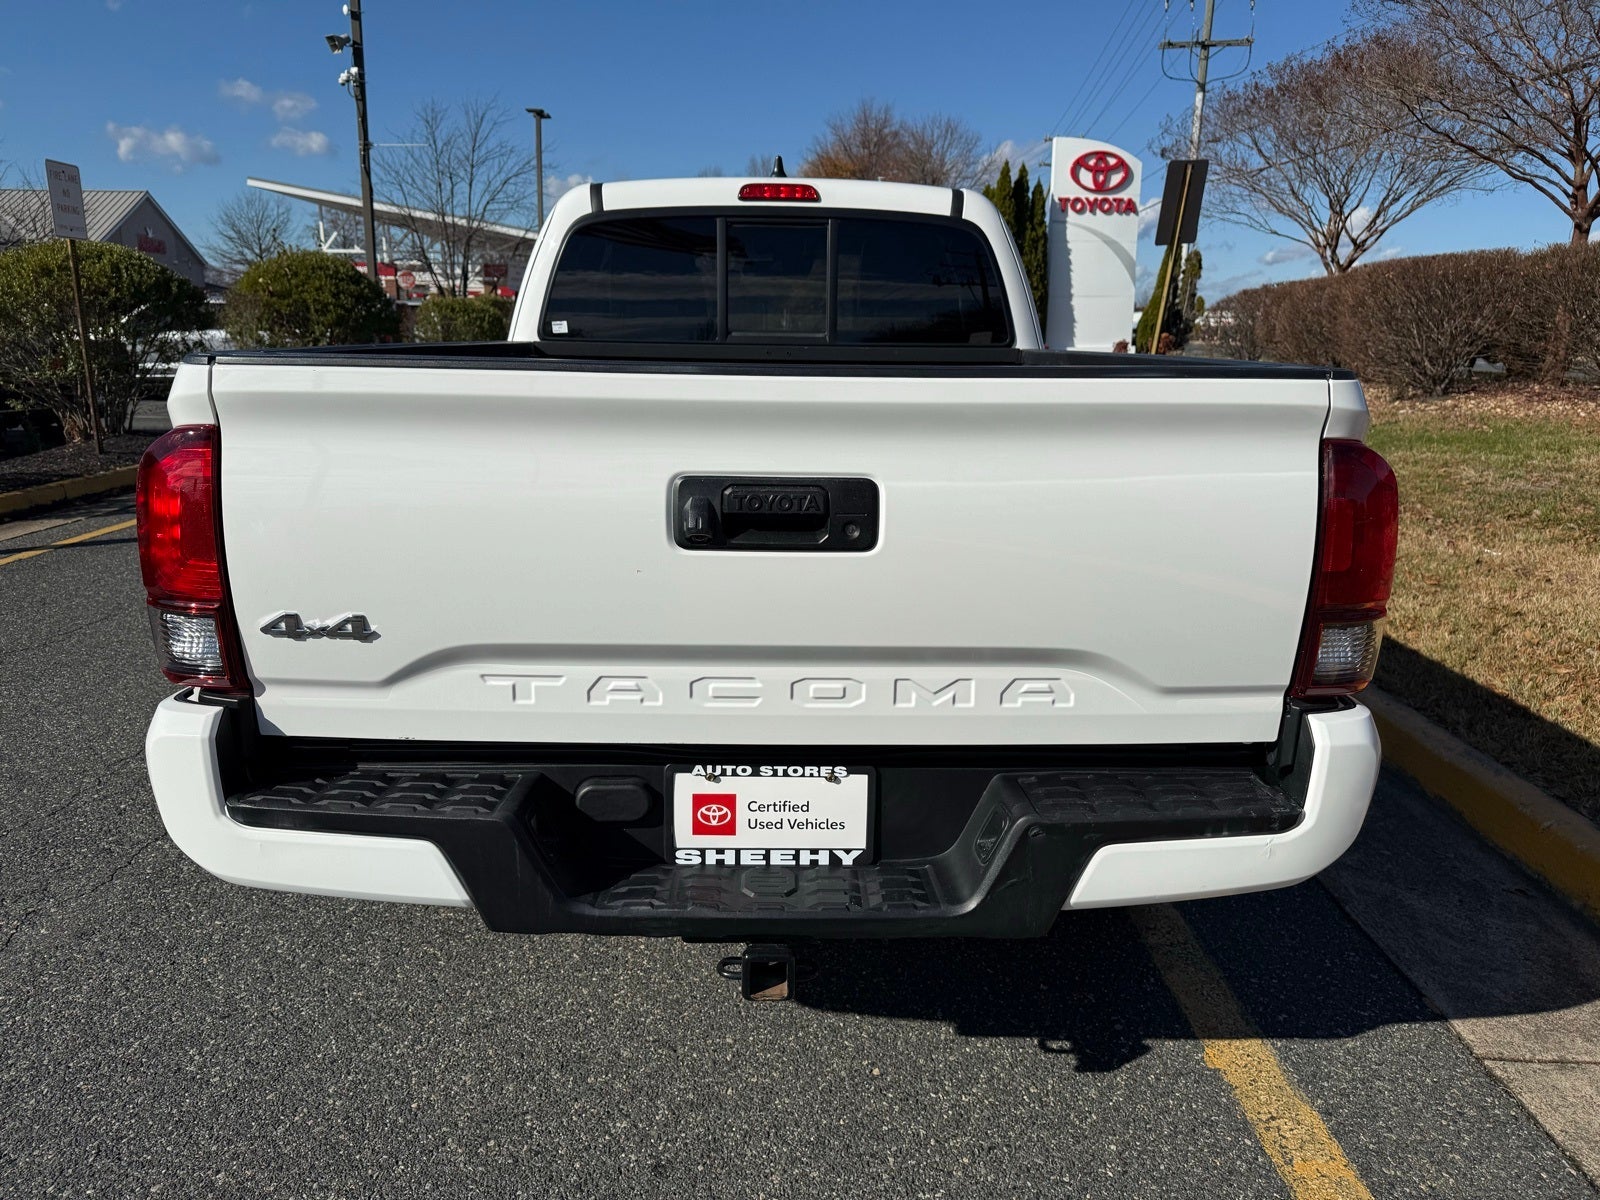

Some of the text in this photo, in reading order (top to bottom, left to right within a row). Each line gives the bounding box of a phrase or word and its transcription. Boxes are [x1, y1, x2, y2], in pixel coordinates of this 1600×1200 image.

[57, 203, 80, 216] PARKING
[1058, 197, 1138, 214] TOYOTA
[731, 494, 821, 512] TOYOTA
[480, 673, 1075, 708] TACOMA
[691, 765, 848, 777] AUTO STORES
[747, 800, 810, 813] Certified
[747, 818, 845, 830] Used Vehicles
[675, 849, 864, 866] SHEEHY
